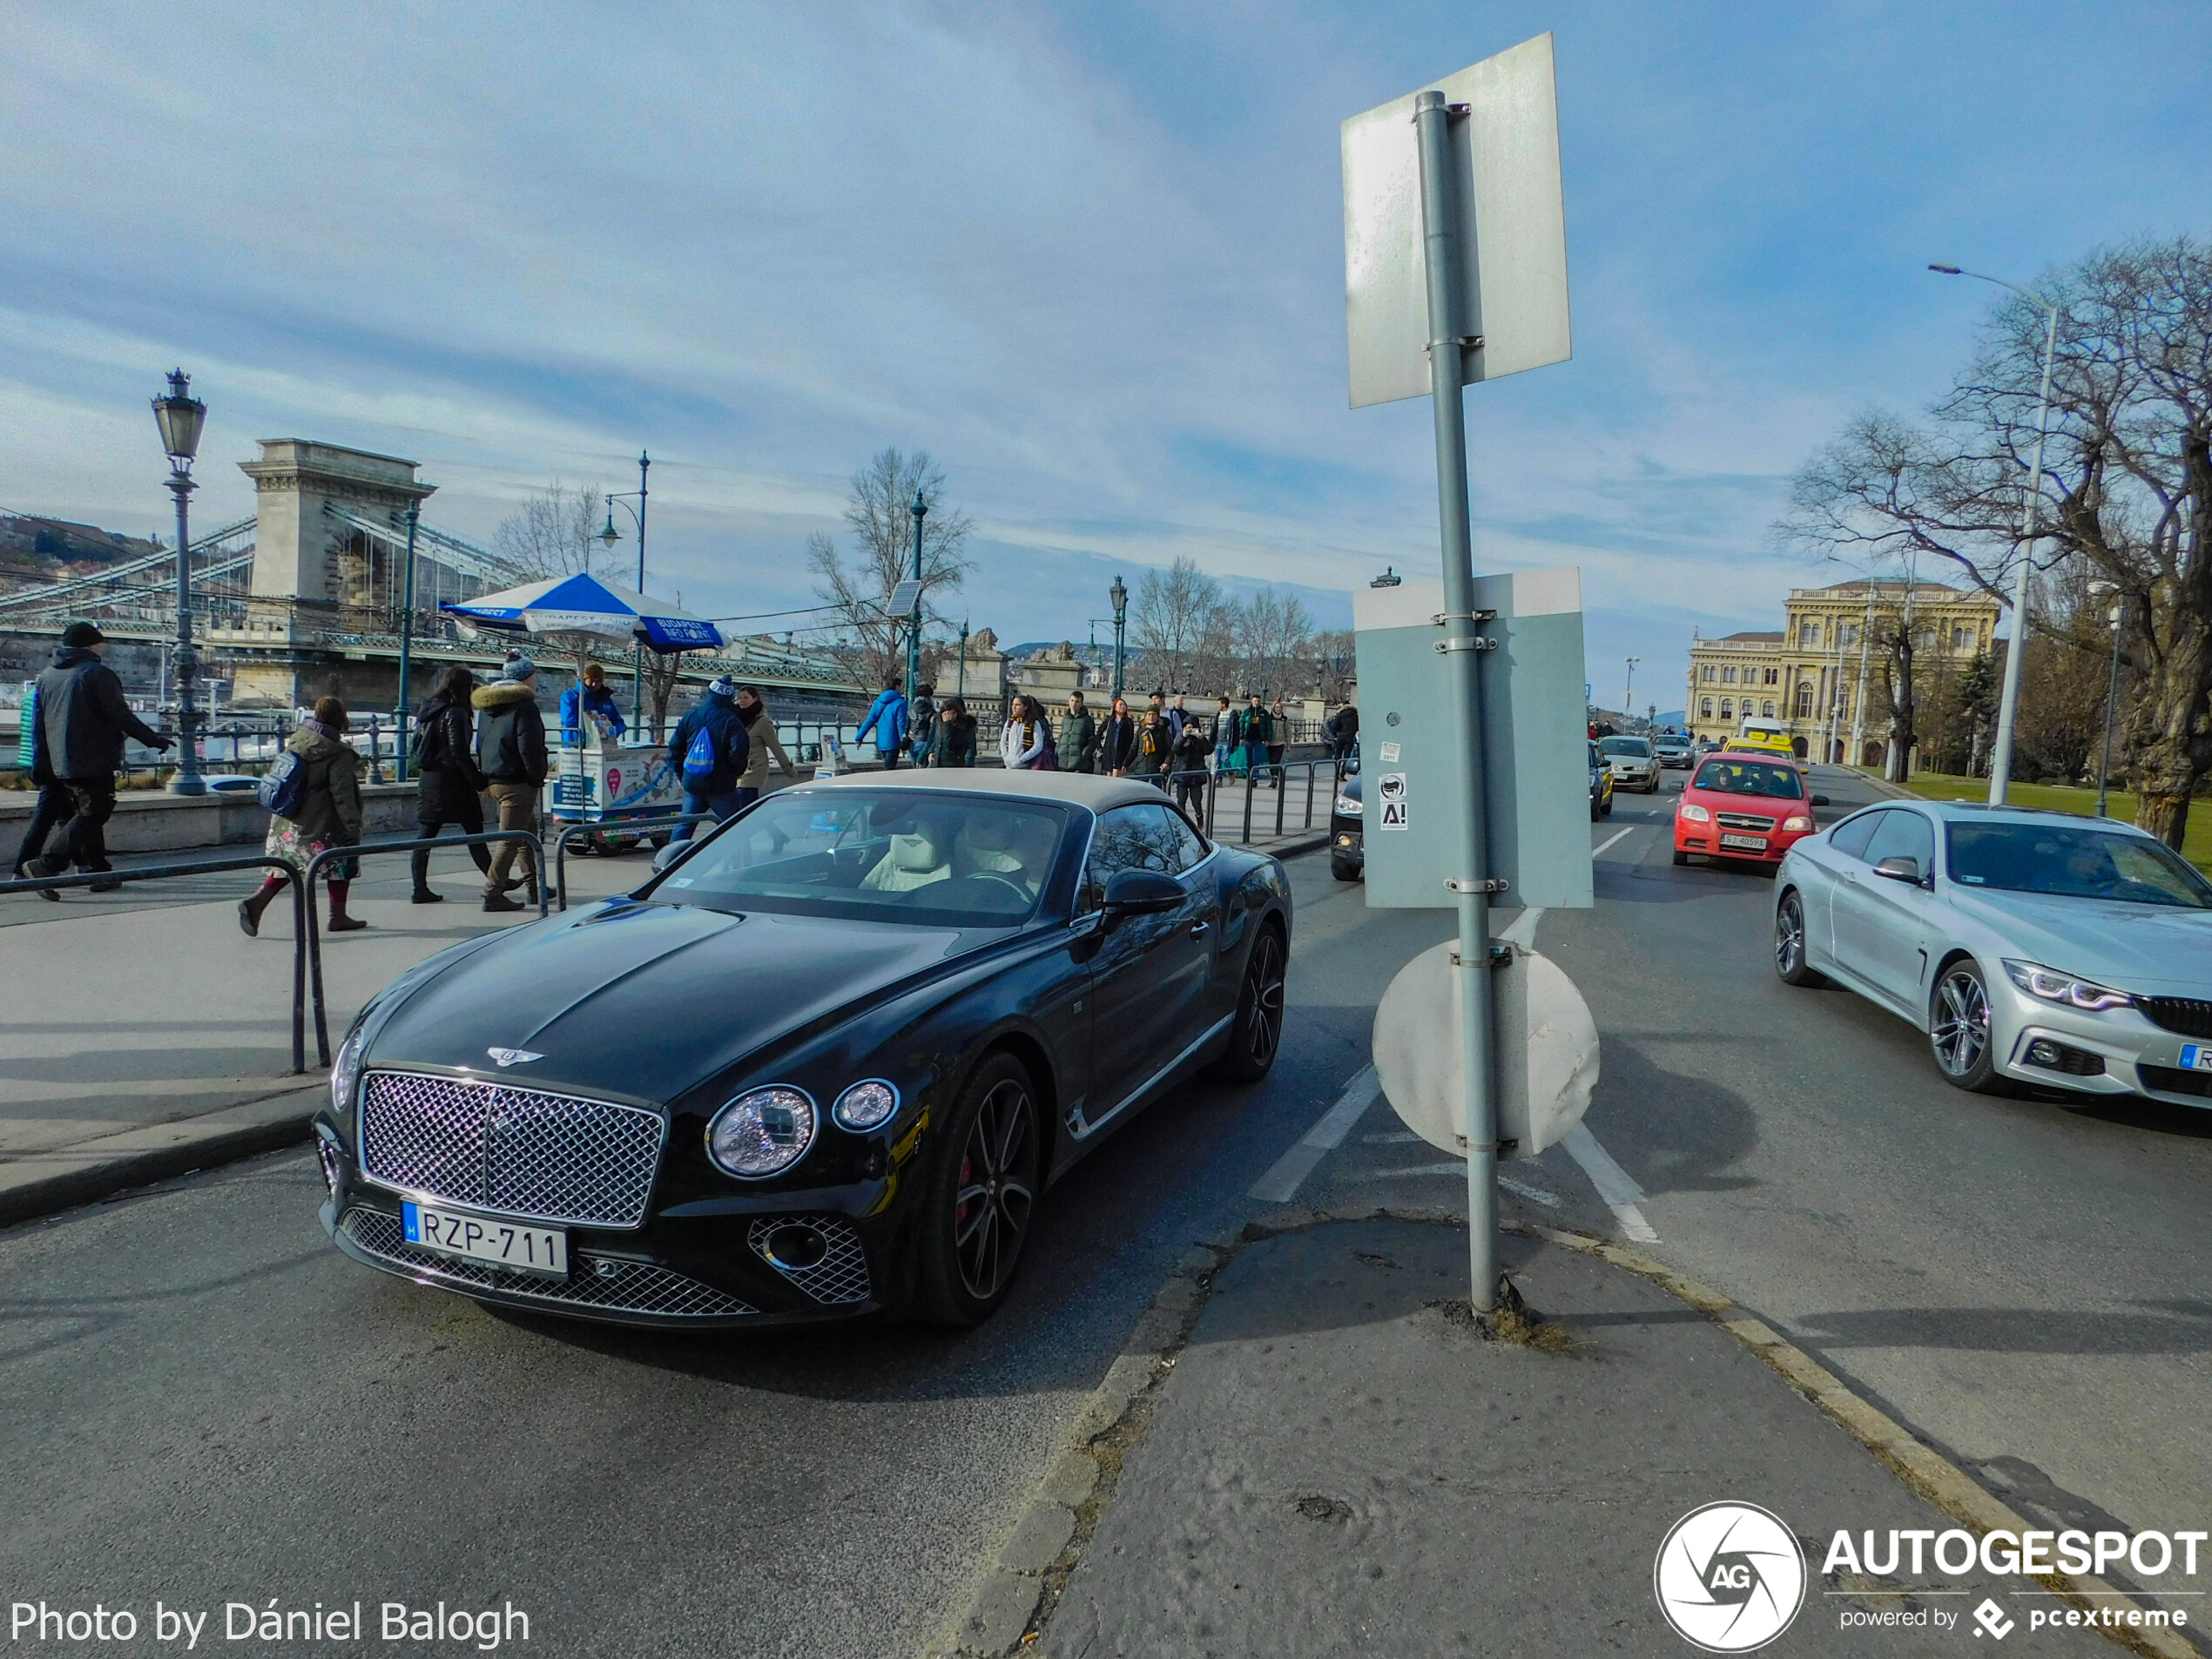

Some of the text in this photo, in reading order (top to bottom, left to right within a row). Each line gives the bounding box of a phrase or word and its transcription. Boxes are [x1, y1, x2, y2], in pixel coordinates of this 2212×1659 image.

[657, 619, 704, 629] BUDAPEST
[663, 628, 711, 639] INFO POINT
[1739, 837, 1764, 847] 4059A
[423, 1211, 555, 1266] RZP-711
